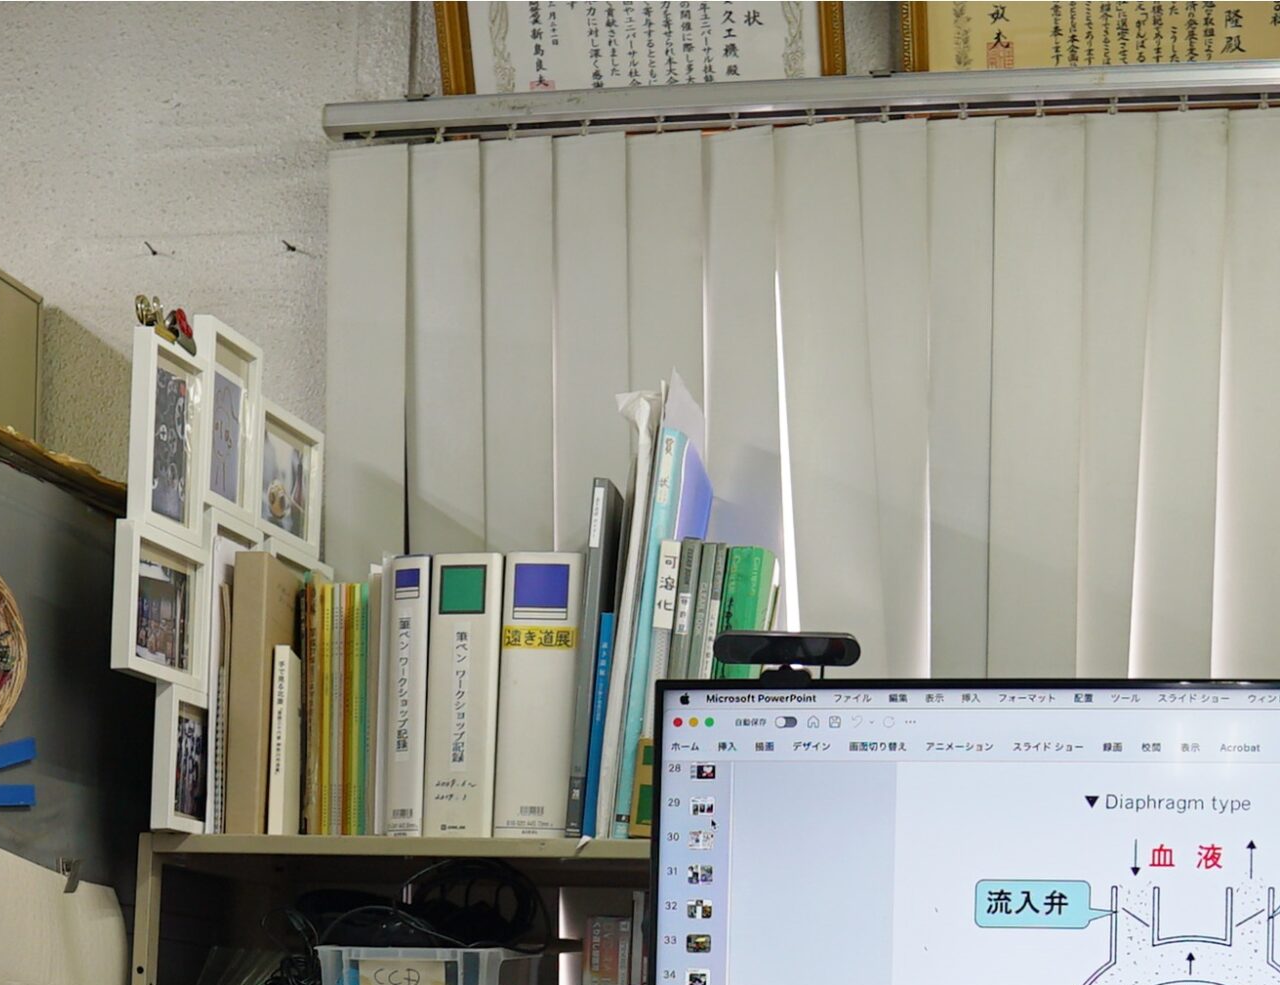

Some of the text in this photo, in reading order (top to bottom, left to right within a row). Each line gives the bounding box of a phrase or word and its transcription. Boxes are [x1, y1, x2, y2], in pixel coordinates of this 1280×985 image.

[744, 9, 764, 26] 状
[395, 617, 411, 752] 筆ペン ワークショップ記録
[451, 631, 468, 763] 筆ペン ワークショップ記録
[706, 693, 816, 704] Microsoft PowerPoint
[833, 693, 872, 704] ファイル
[925, 693, 944, 704] 表示
[998, 693, 1056, 704] フォーマット
[1111, 693, 1140, 704] ツール
[1157, 693, 1196, 704] スライド
[1200, 693, 1230, 704] ショー
[1247, 693, 1280, 704] ウィン
[671, 741, 699, 752] ホーム
[793, 741, 830, 752] デザイン
[849, 741, 907, 752] 画面切り替え
[926, 741, 993, 752] アニメーション
[1013, 741, 1051, 752] スライド
[1055, 741, 1084, 752] ショー
[1219, 741, 1260, 752] Acrobat
[668, 763, 681, 773] 28
[667, 798, 681, 808] 29
[1106, 794, 1252, 814] Diaphragm type
[666, 832, 680, 842] 30
[666, 867, 678, 877] 31
[665, 901, 678, 911] 32
[986, 890, 1069, 916] 流入弁
[664, 935, 677, 945] 33
[663, 970, 676, 980] 34
